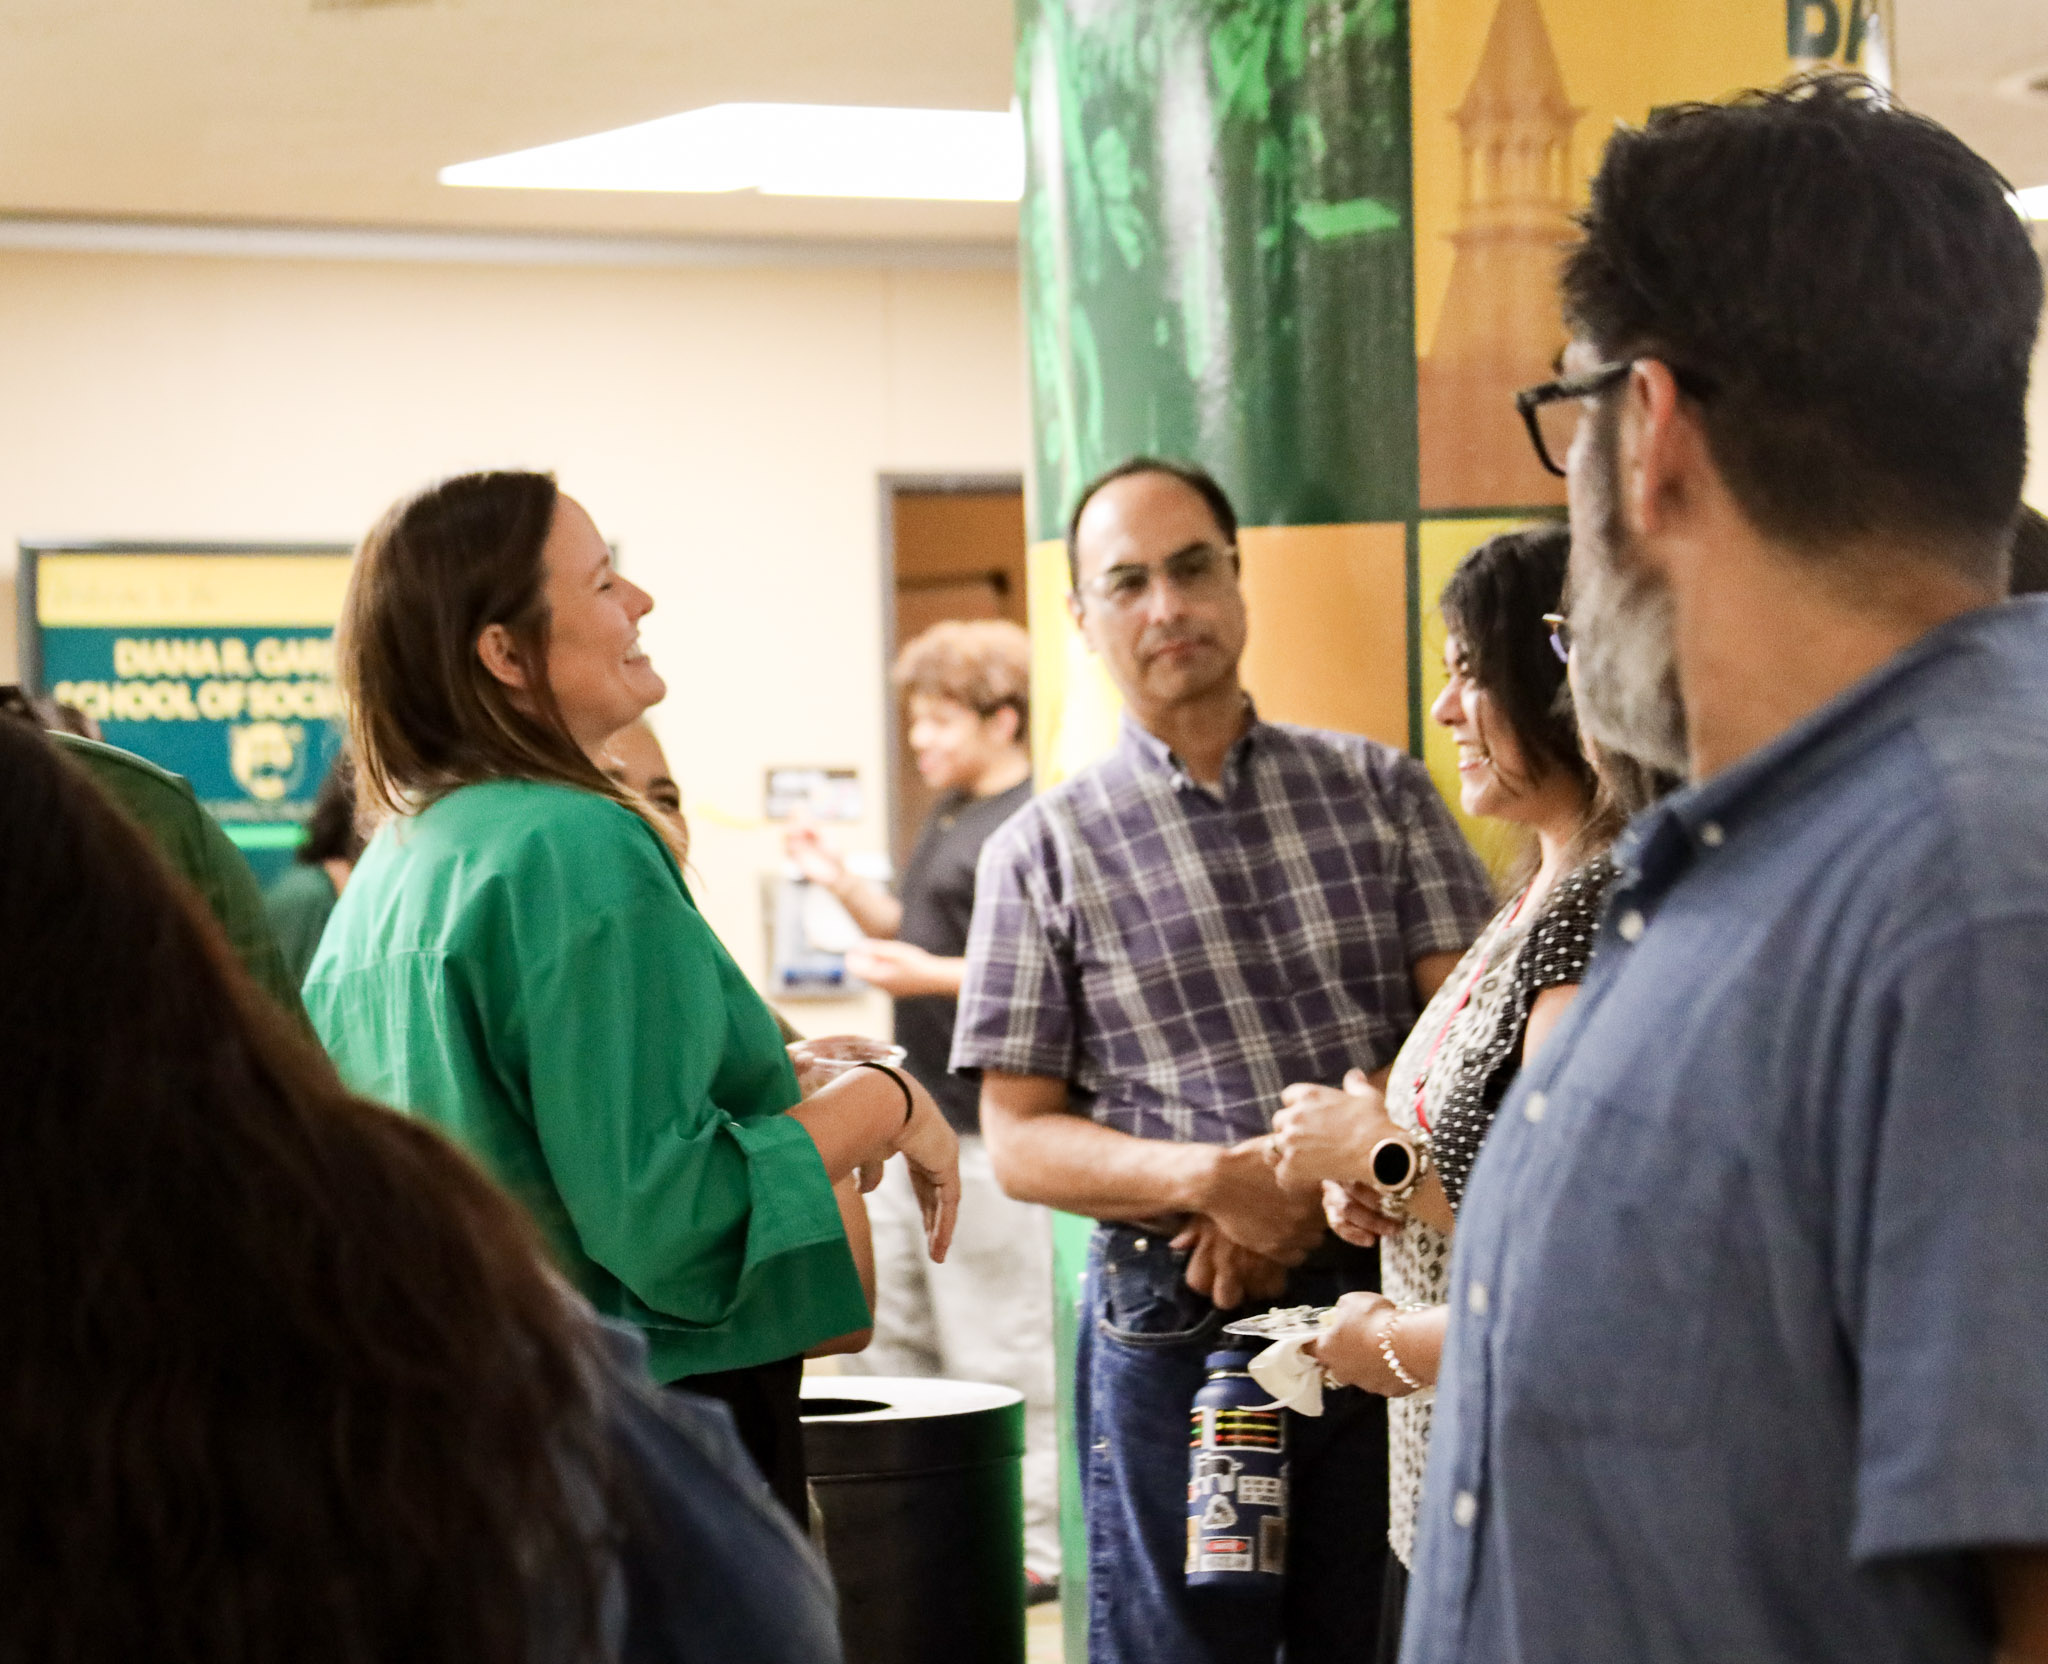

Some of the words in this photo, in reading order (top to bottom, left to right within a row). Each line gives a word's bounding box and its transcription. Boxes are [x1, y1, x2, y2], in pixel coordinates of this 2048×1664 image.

[114, 637, 220, 677] DIANA
[54, 681, 198, 720] SCHOOL
[196, 681, 245, 720] OF
